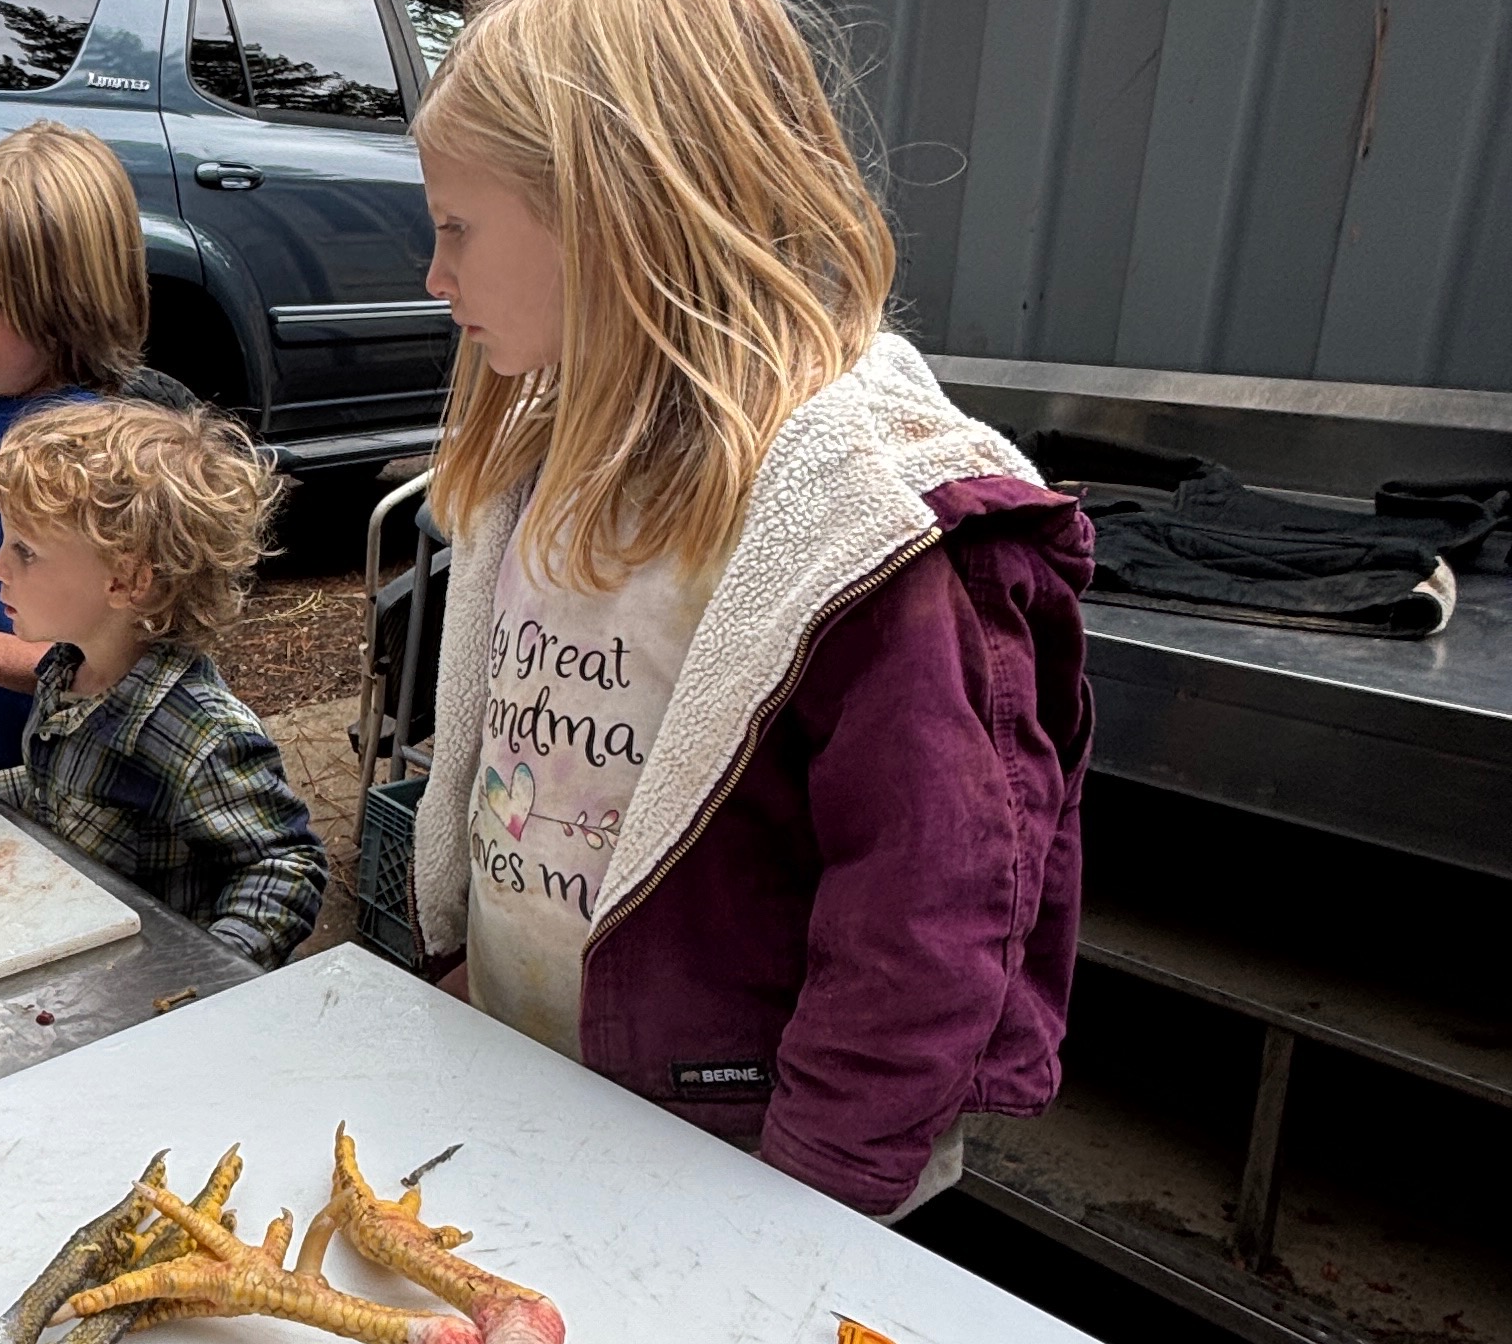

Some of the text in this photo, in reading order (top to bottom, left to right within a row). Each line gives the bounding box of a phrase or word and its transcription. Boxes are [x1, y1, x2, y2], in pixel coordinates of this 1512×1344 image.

[516, 619, 631, 691] Great
[488, 685, 644, 768] andma
[538, 863, 601, 922] m
